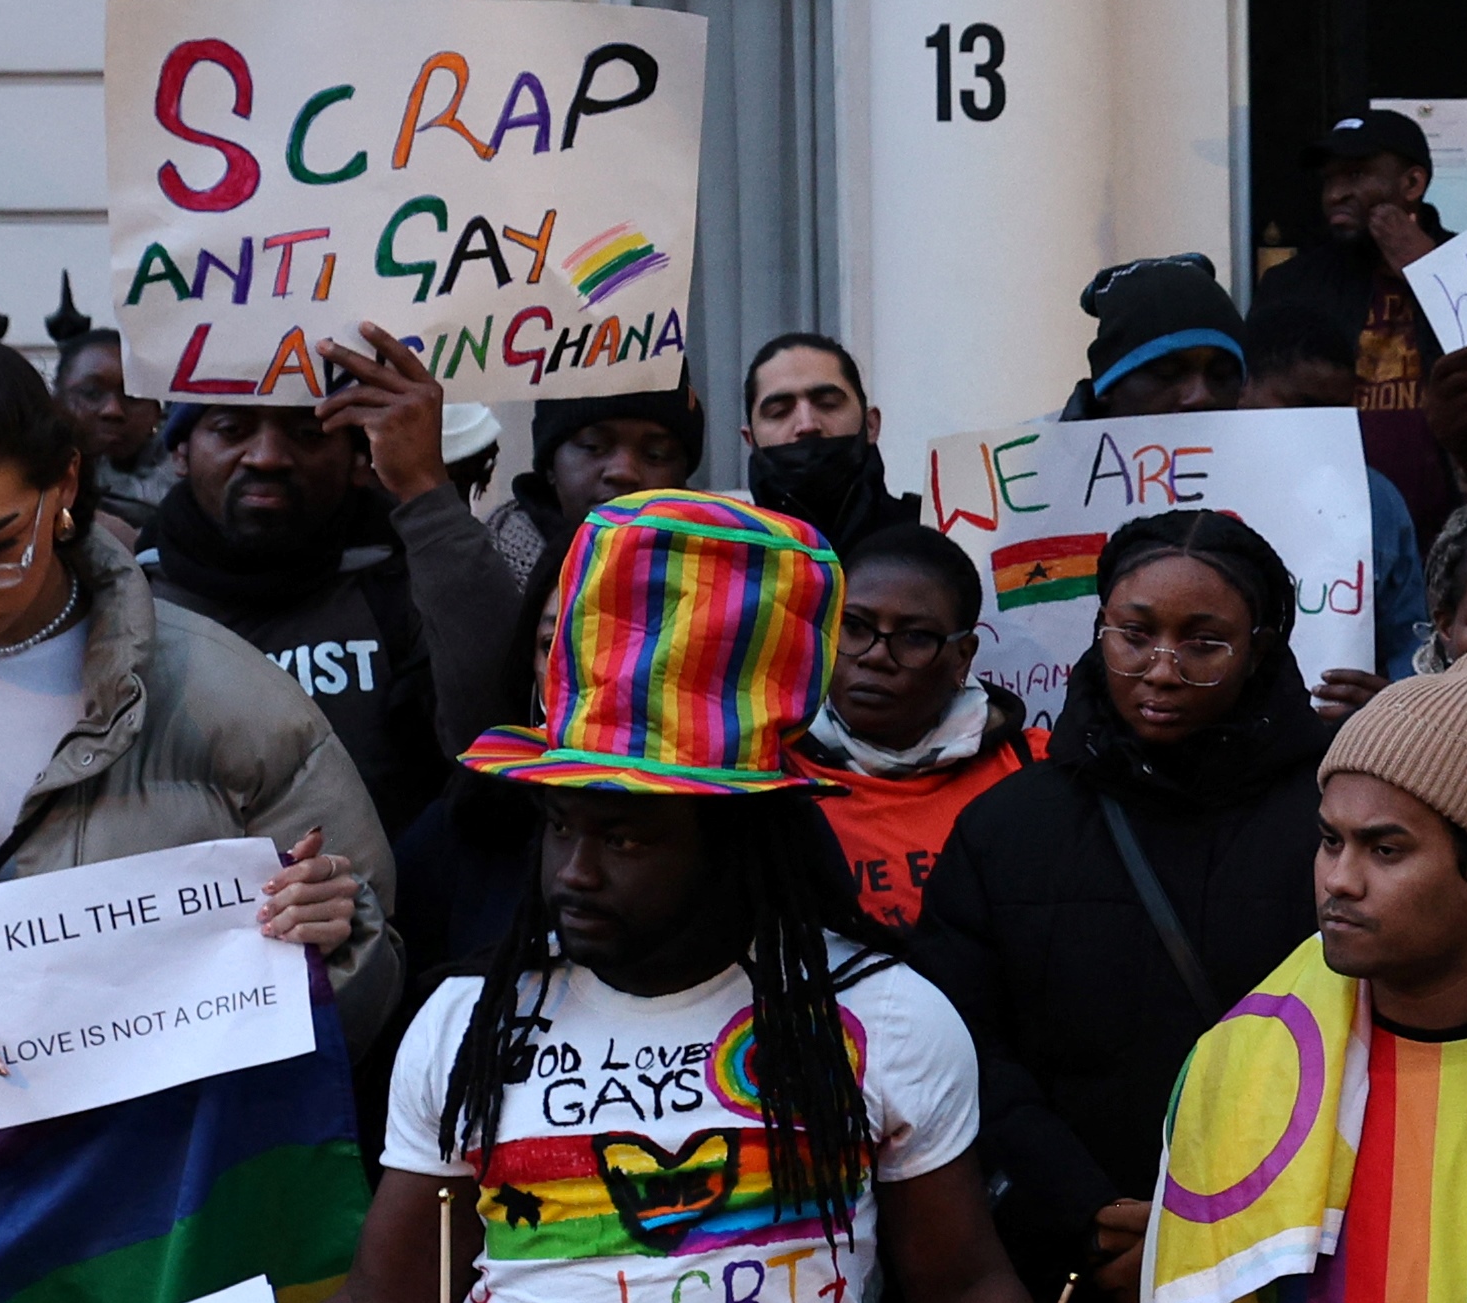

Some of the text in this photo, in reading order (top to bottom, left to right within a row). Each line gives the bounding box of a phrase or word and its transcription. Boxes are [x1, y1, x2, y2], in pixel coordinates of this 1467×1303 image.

[925, 22, 1006, 123] 13
[154, 37, 659, 213] SCRAP
[121, 193, 557, 307] ANTI GAY
[503, 305, 685, 386] GHANA
[930, 432, 1214, 535] WE ARE
[3, 876, 256, 952] KILL THE BILL
[2, 984, 277, 1066] LOVE IS NOT A CRIME
[601, 1037, 714, 1071] LOVES
[543, 1067, 704, 1128] GAYS
